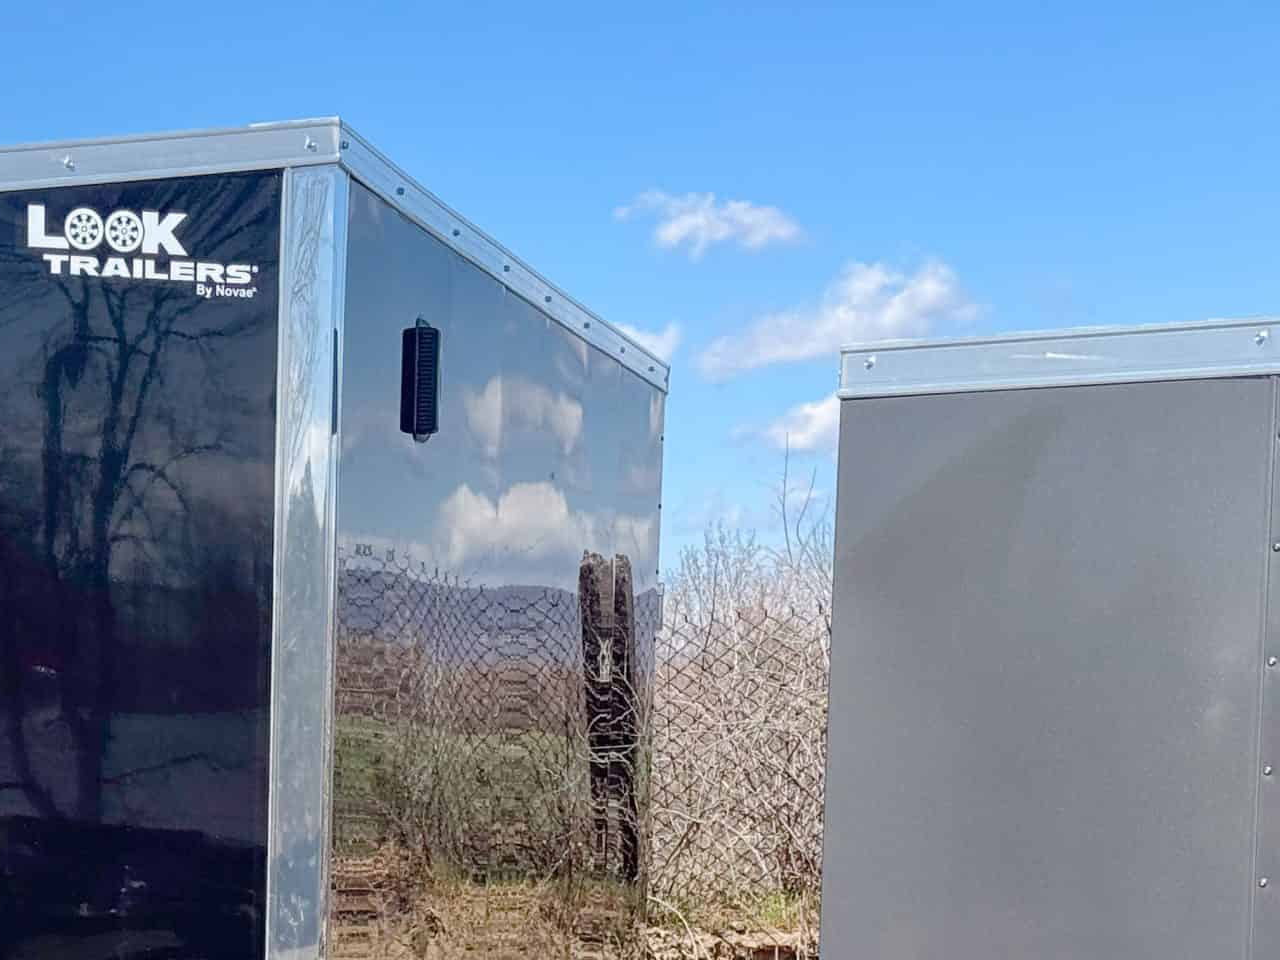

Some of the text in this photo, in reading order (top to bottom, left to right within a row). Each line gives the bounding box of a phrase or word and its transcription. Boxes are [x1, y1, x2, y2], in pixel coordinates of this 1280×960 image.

[27, 204, 189, 256] LOOK
[43, 253, 253, 284] TRAILERS
[196, 284, 253, 298] By Novae
